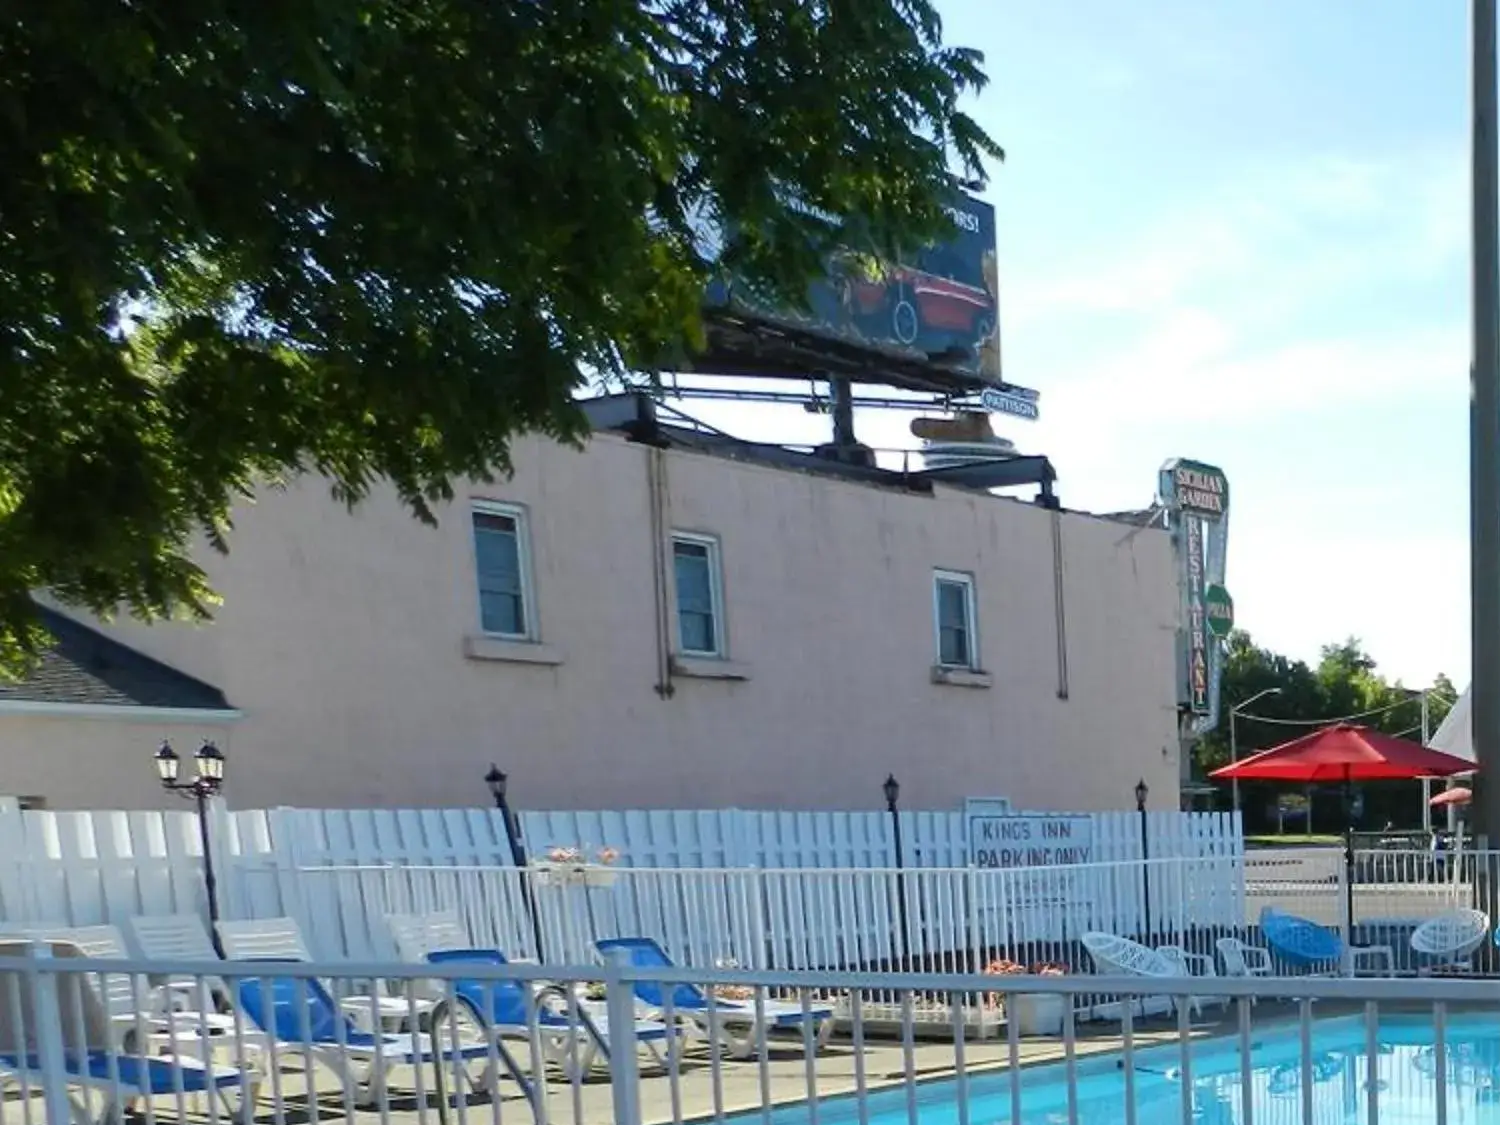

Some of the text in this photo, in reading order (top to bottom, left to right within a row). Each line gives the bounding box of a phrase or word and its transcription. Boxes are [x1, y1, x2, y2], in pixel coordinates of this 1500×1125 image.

[1186, 517, 1206, 704] RESTAURANT
[982, 820, 1072, 841] KINGS INN
[976, 846, 1090, 868] PARKING ONLY
